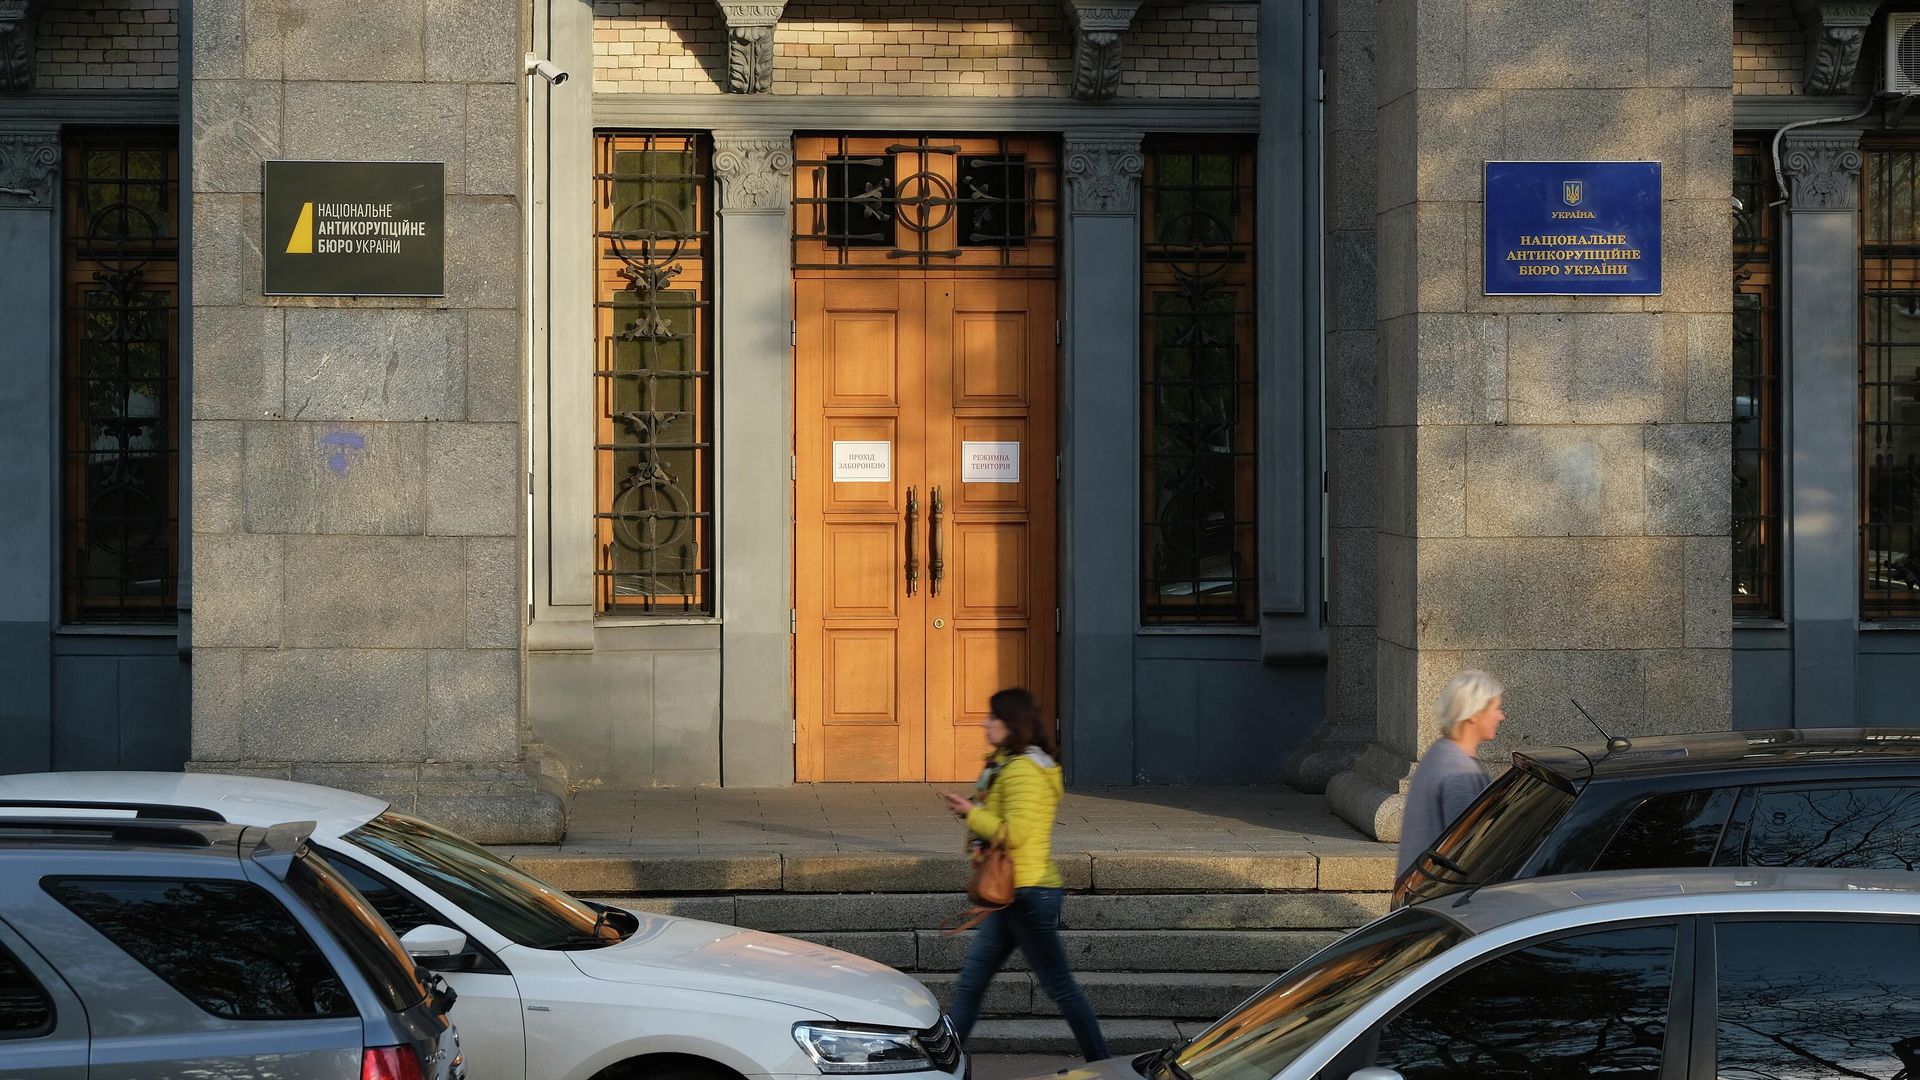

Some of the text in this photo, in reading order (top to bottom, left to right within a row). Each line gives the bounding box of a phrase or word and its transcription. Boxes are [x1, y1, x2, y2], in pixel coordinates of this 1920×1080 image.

[318, 203, 392, 219] НАЦІОНАЛЬНЕ
[1552, 210, 1595, 219] УКРАЇНА
[318, 220, 425, 237] АНТИКОРУПЦІЙНЕ
[318, 238, 401, 254] БЮРО УКРАЇНИ
[1520, 235, 1626, 246] НАЦІОНАЛЬНЕ
[1506, 249, 1641, 261] АНТИКОРУПЦІЙНЕ
[1519, 263, 1628, 276] БЮРО УКРАЇНИ
[848, 453, 875, 462] ПРОХІД
[972, 453, 1010, 462] РЕЖИМНА
[838, 462, 886, 470] ЗАБОРОНЕНО
[971, 462, 1011, 470] ТЕРИТОРІЯ
